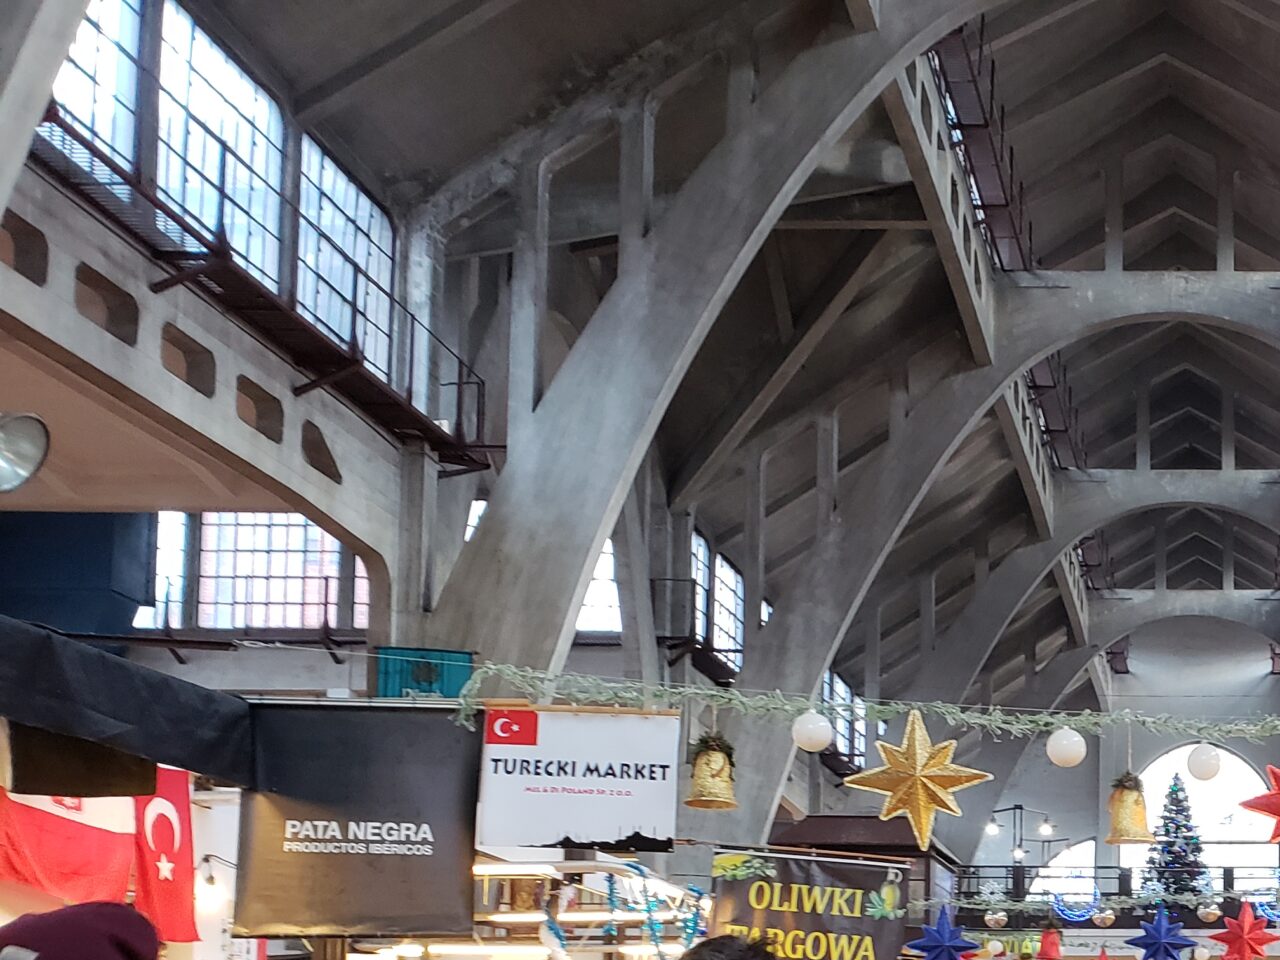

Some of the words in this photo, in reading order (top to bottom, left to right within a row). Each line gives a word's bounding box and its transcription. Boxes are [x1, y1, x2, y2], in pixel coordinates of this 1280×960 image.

[491, 757, 576, 777] TURECKI
[582, 762, 671, 782] MARKET
[284, 819, 343, 841] PATA
[347, 821, 435, 843] NEGRA
[282, 841, 368, 855] PRODUCTOS
[748, 880, 864, 917] OLIWKI
